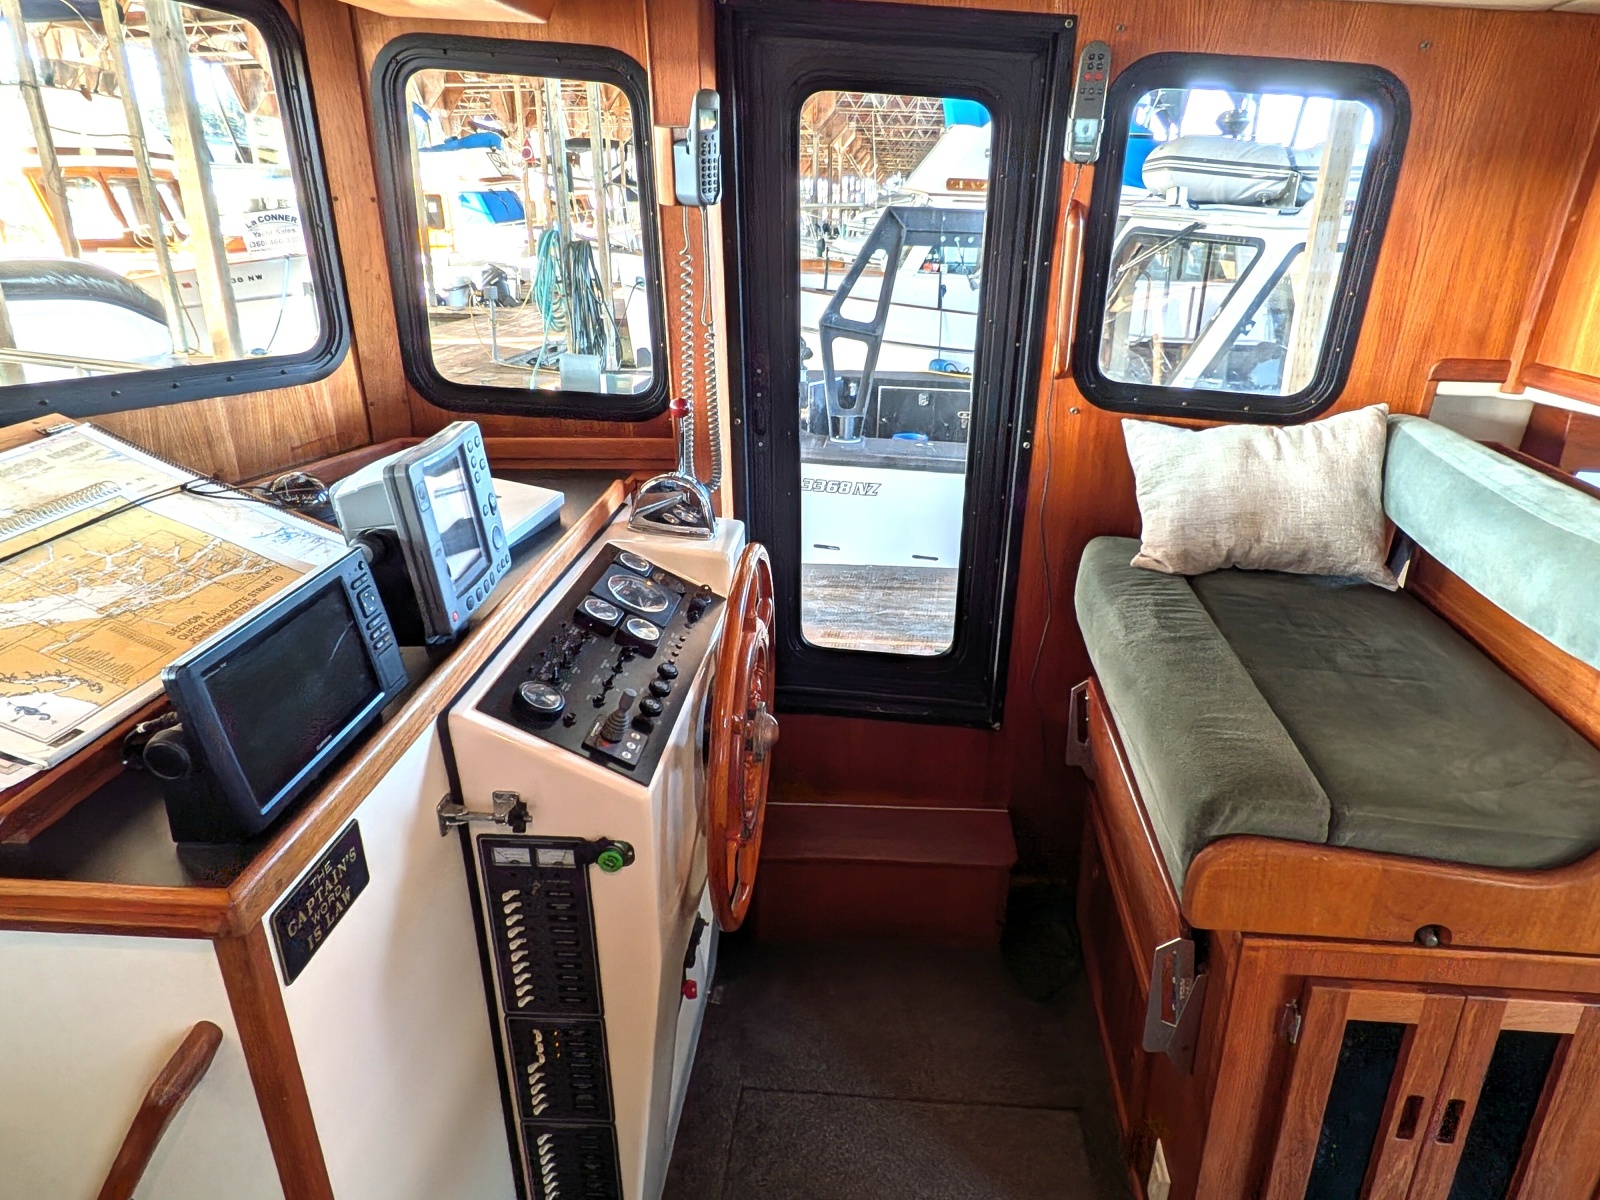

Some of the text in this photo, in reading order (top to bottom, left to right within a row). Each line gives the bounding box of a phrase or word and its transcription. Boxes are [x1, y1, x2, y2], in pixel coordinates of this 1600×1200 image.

[245, 214, 297, 229] La CONNER
[247, 274, 263, 282] NW
[801, 477, 882, 496] 3368 NZ
[177, 622, 208, 641] QUEEN
[206, 596, 249, 624] CHARLOTTE
[248, 582, 272, 597] STRAIT
[271, 575, 284, 584] TO
[190, 614, 233, 645] JOHNSTONE
[234, 599, 260, 615] STRAIT
[166, 614, 203, 637] SECTION
[287, 846, 357, 937] CAPTAIN'S
[309, 860, 333, 889] THE
[308, 885, 351, 951] IS LAW
[312, 885, 342, 924] WORD
